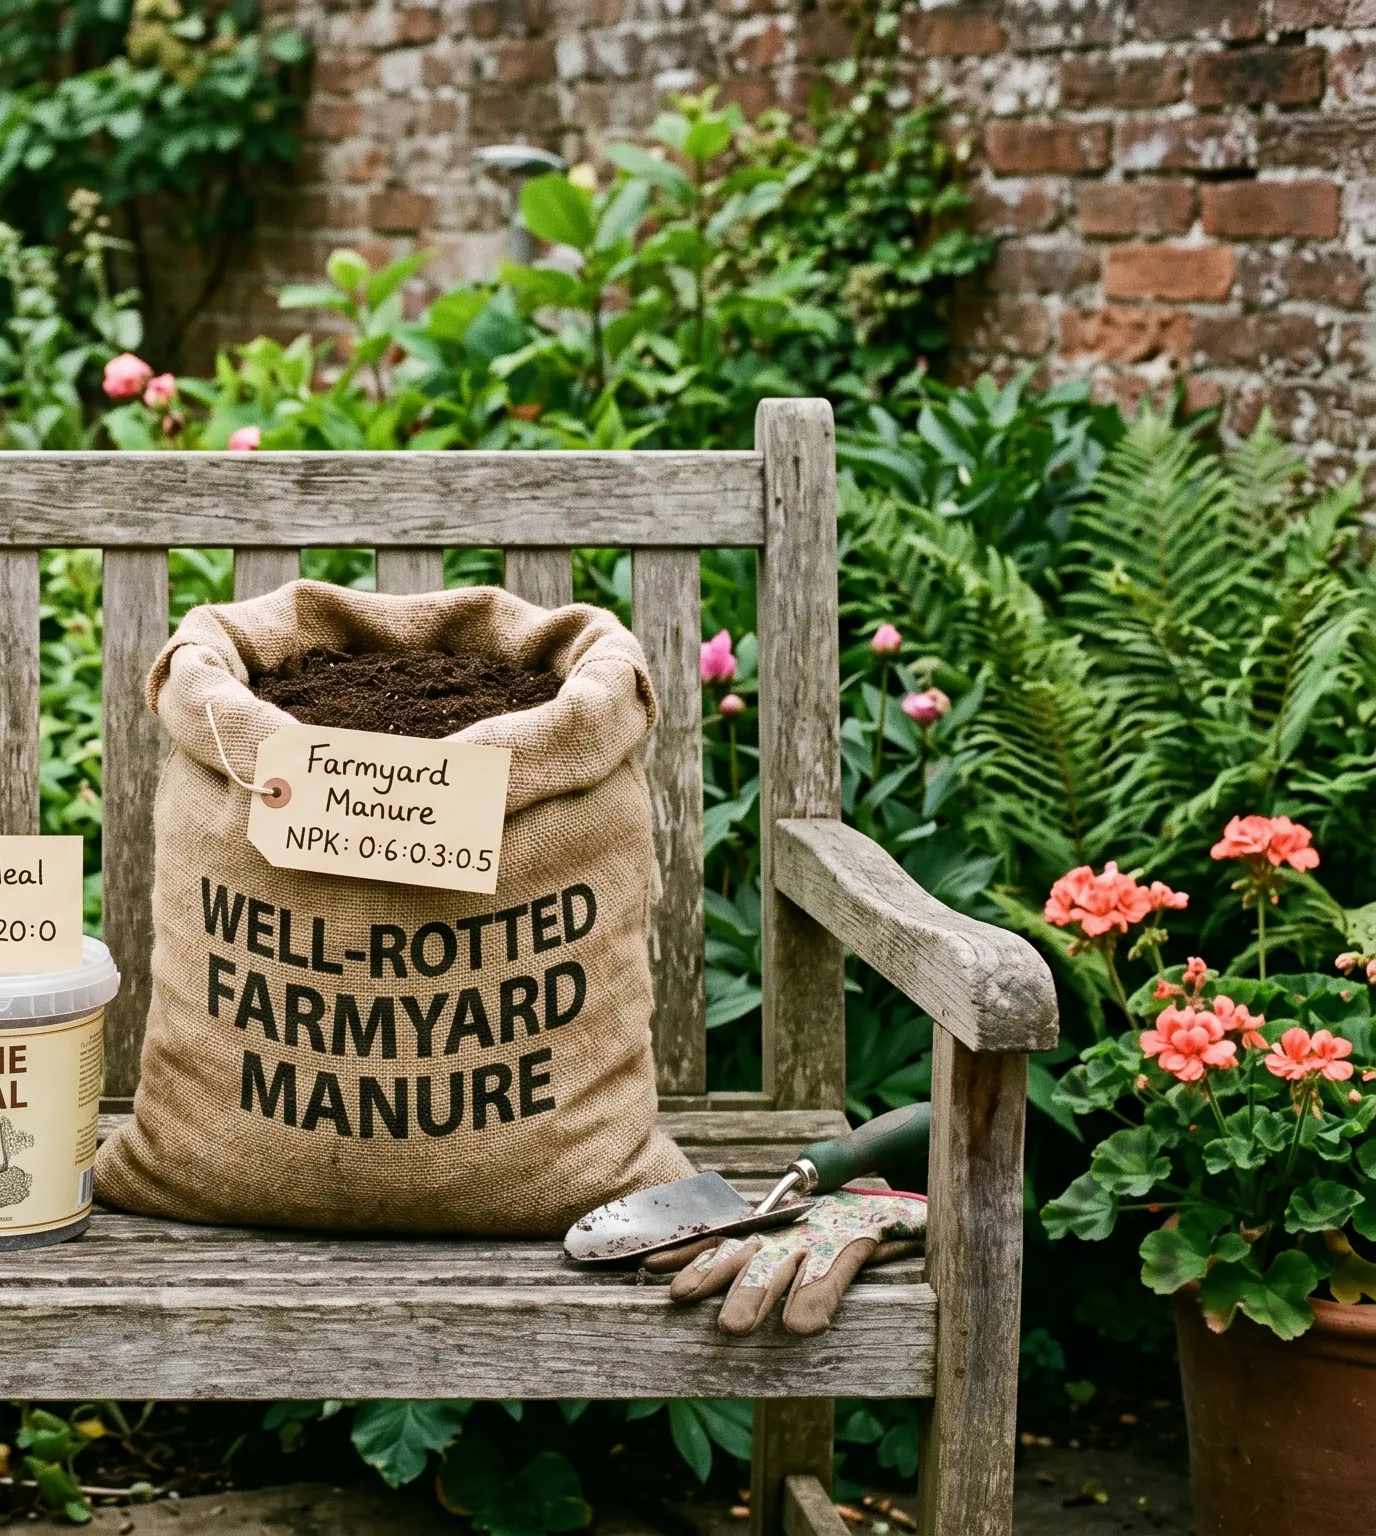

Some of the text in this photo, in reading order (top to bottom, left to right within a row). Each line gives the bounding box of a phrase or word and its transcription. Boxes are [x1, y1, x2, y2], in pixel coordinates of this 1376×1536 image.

[307, 743, 450, 795] Farmyard
[325, 787, 437, 825] Manure
[285, 825, 494, 873] NPK: 0:6:0.3:0.5
[200, 876, 597, 979] WELL-ROTTED
[207, 952, 588, 1060] FARMYARD
[240, 1047, 556, 1139] MANURE
